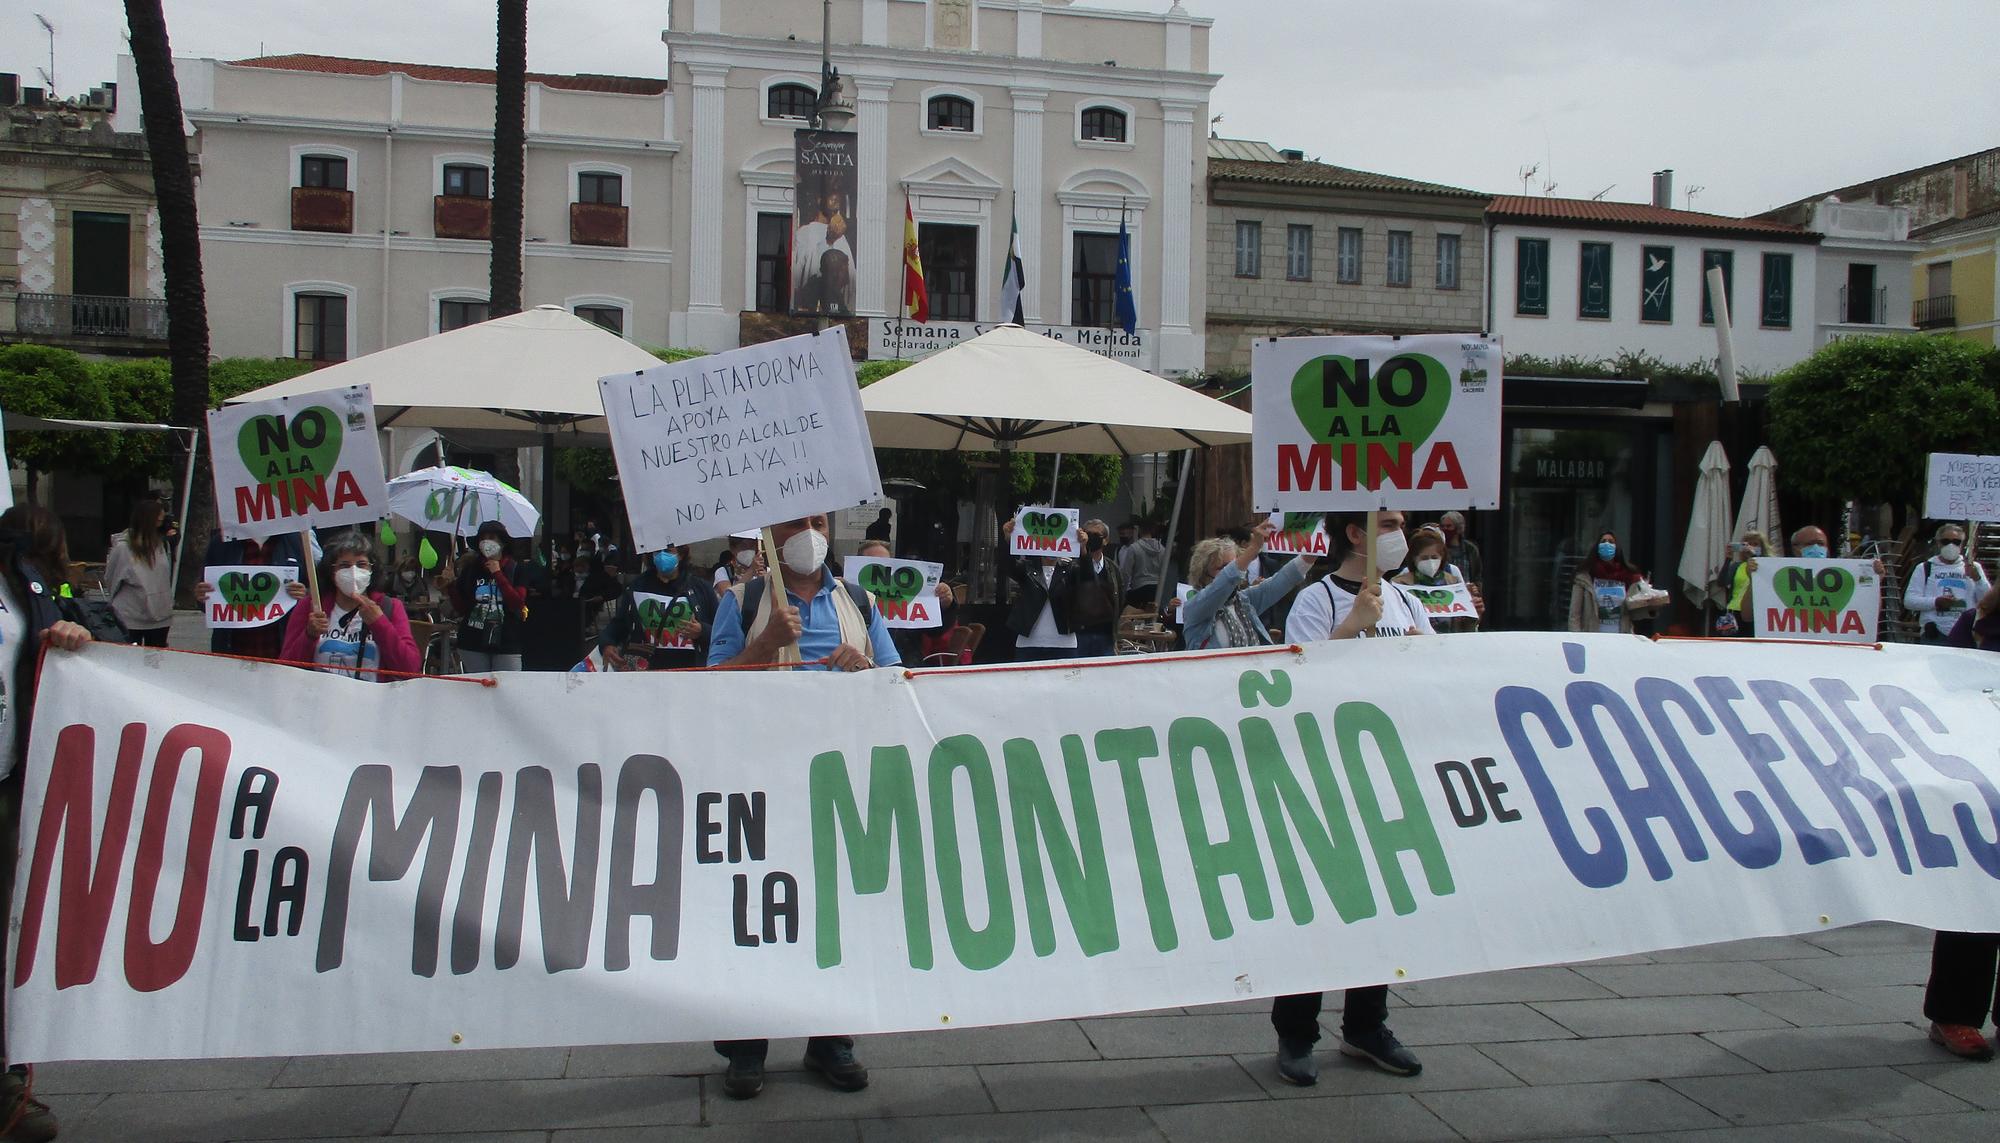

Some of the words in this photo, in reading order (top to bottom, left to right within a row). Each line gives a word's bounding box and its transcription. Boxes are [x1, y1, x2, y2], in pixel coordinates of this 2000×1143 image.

[801, 152, 854, 167] SANTA
[883, 321, 960, 339] Semana
[1042, 328, 1063, 341] de
[1078, 329, 1142, 346] Mérida
[883, 338, 939, 350] Declarada
[629, 384, 668, 418] LA
[672, 352, 824, 408] PLATAFORMA
[1322, 358, 1428, 409] NO
[667, 406, 731, 436] APOYA
[744, 399, 759, 418] A
[1328, 415, 1351, 437] A
[1361, 415, 1401, 437] LA
[255, 410, 327, 456] NO
[641, 433, 732, 471] NUESTRO
[737, 411, 824, 447] ALCALDE
[266, 460, 282, 477] A
[286, 455, 314, 475] LA
[696, 446, 787, 485] SALAYA
[1277, 441, 1469, 492] MINA
[1537, 460, 1604, 478] MALABAR
[234, 470, 369, 524] MINA
[676, 504, 705, 525] NO
[714, 498, 729, 516] A
[739, 489, 764, 510] LA
[1031, 513, 1062, 528] NO
[1041, 528, 1054, 536] LA
[1017, 535, 1072, 552] MINA
[1267, 530, 1327, 554] MINA
[230, 572, 272, 592] NO
[870, 565, 915, 588] NO
[1788, 568, 1843, 593] NO
[232, 593, 241, 602] A
[245, 592, 261, 602] LA
[648, 599, 686, 617] NO
[876, 599, 929, 621] INA
[1793, 595, 1804, 607] A
[1809, 595, 1830, 607] LA
[212, 603, 286, 622] MINA
[1766, 608, 1866, 635] MINA
[1494, 642, 2000, 889] CÁCERES
[229, 766, 280, 840] A
[1434, 757, 1522, 828] DE
[696, 791, 766, 864] EN
[808, 669, 1456, 971] MONTAÑA
[14, 722, 232, 992] NO
[315, 754, 684, 978] MINA
[233, 846, 310, 942] LA
[732, 871, 799, 947] LA
